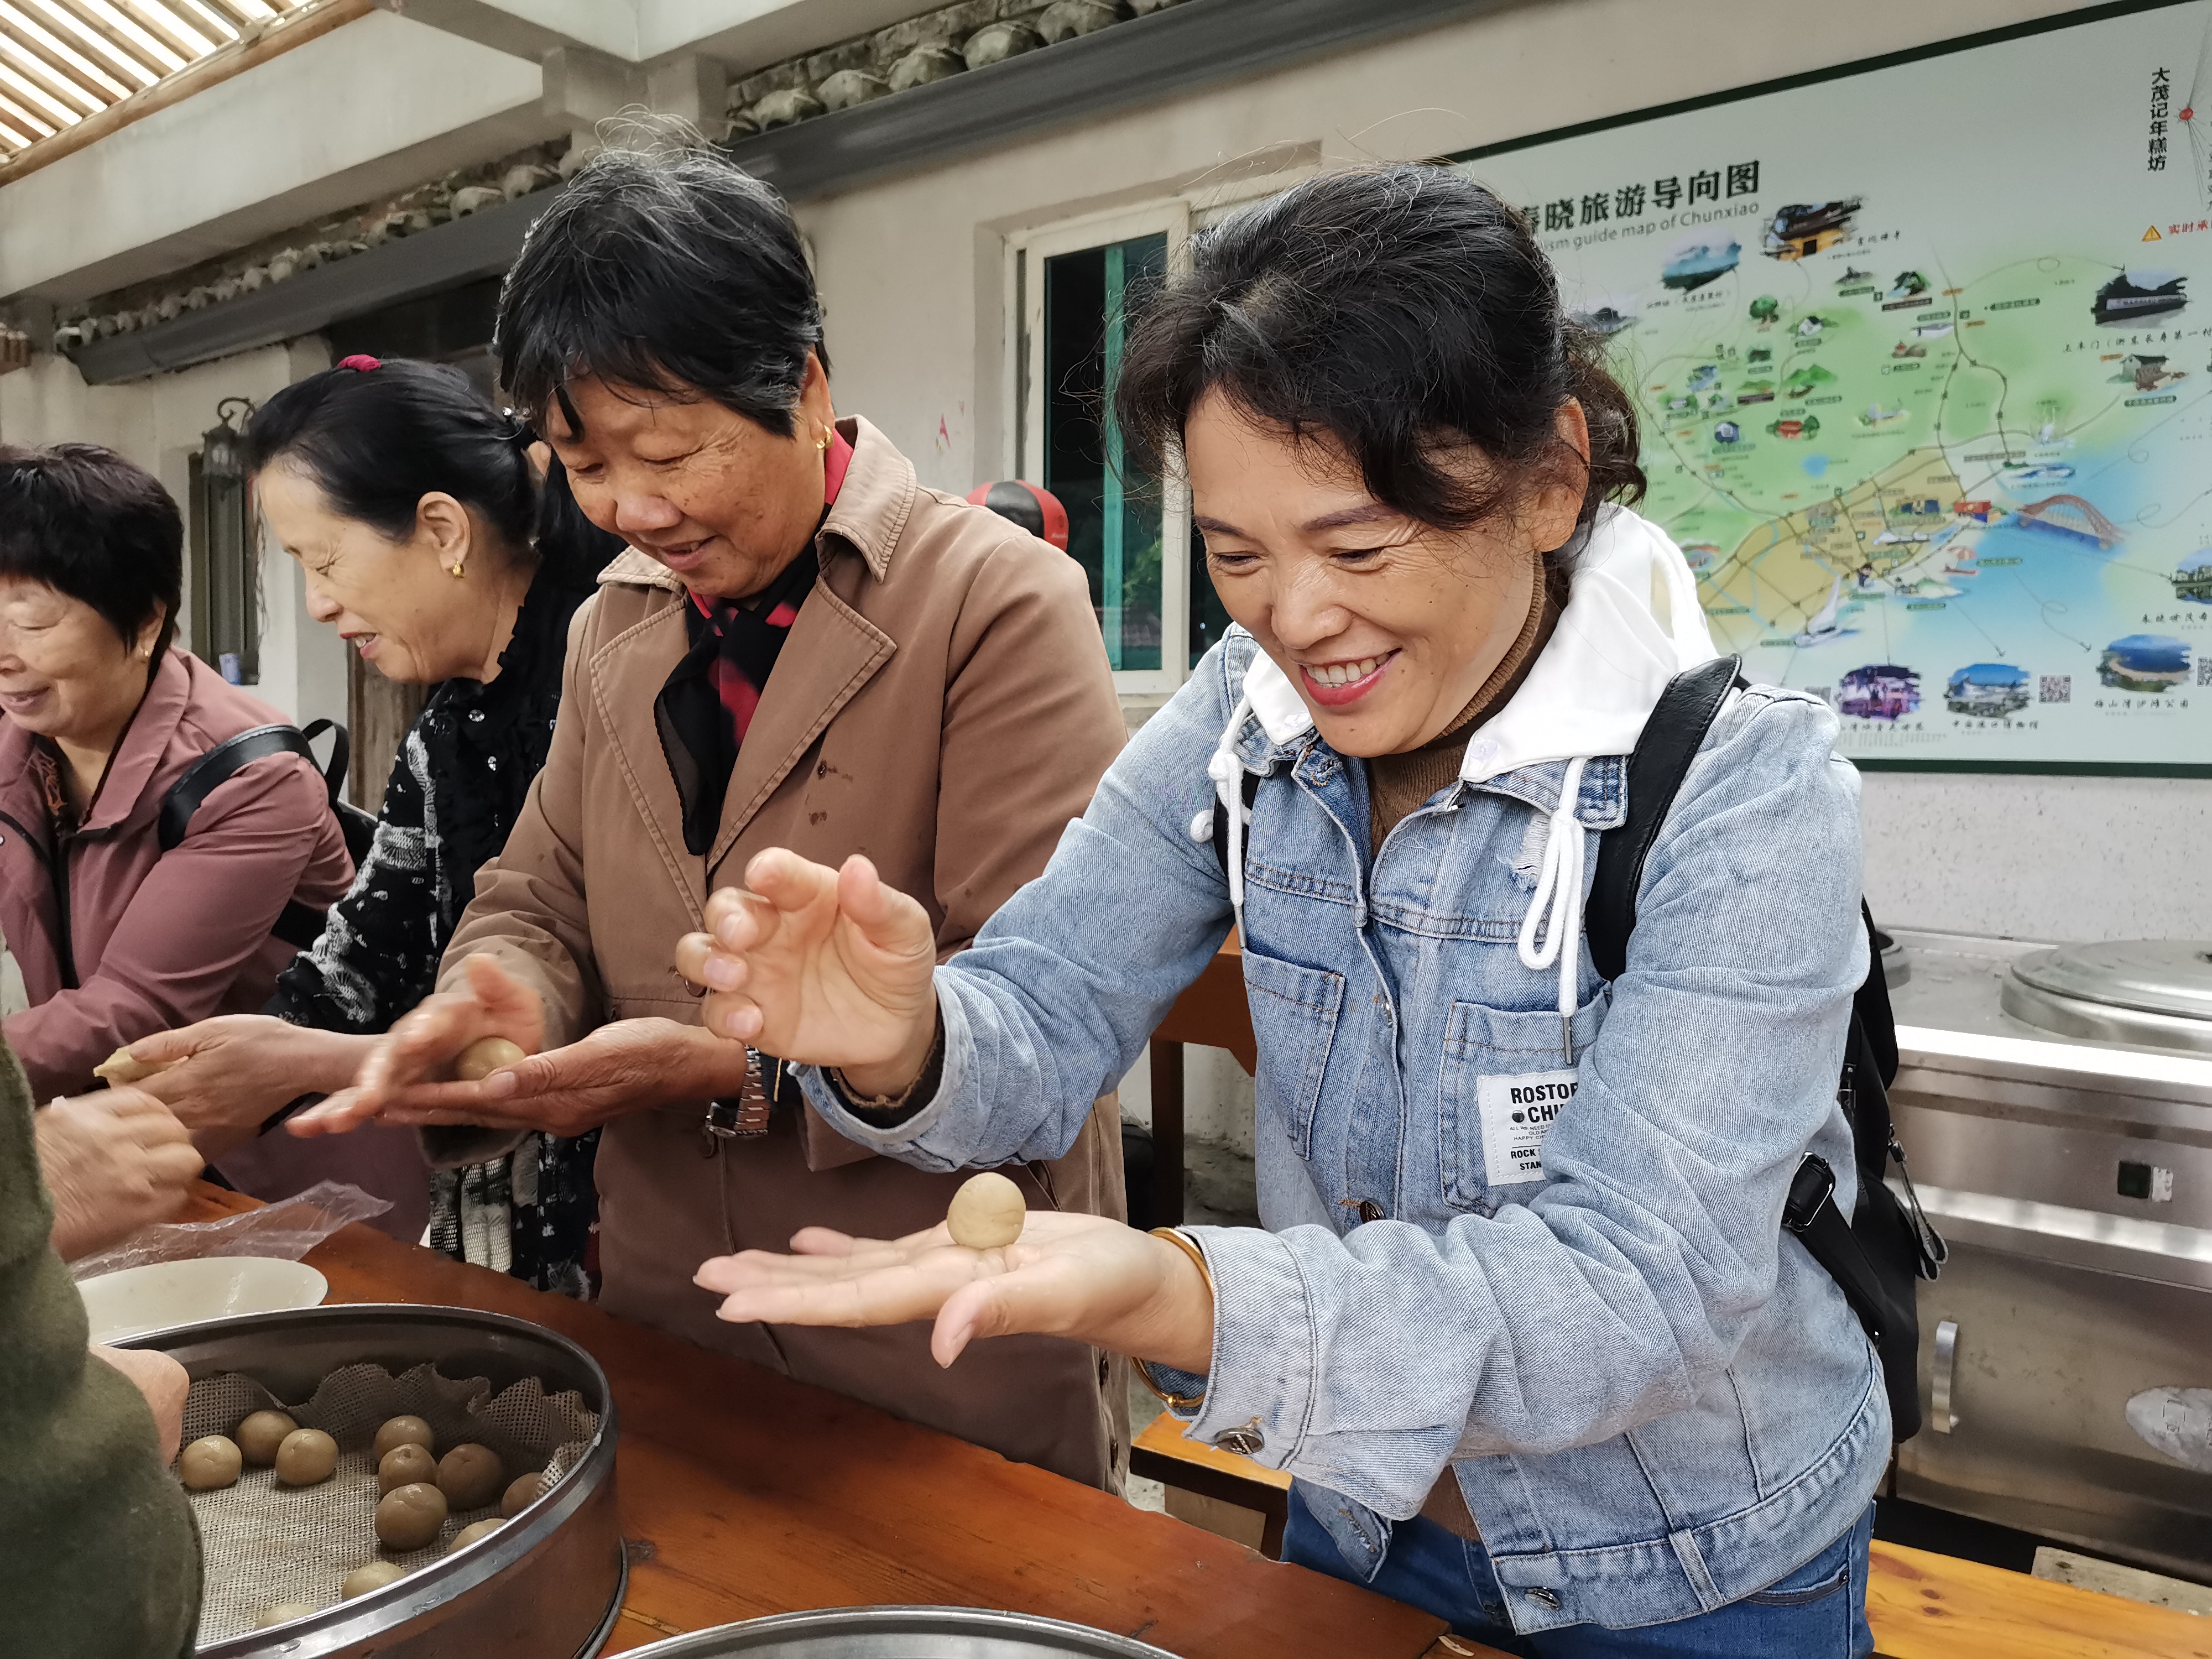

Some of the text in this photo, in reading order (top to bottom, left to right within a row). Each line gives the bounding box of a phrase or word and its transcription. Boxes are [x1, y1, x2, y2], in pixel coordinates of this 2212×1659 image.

[2147, 67, 2170, 172] 大茂记年糕坊
[1573, 226, 1618, 251] guide
[1621, 222, 1656, 238] map
[1660, 213, 1677, 231] of
[1680, 201, 1760, 227] Chunxiao
[2168, 219, 2212, 235] 实时承
[1510, 1149, 1536, 1159] ROCK
